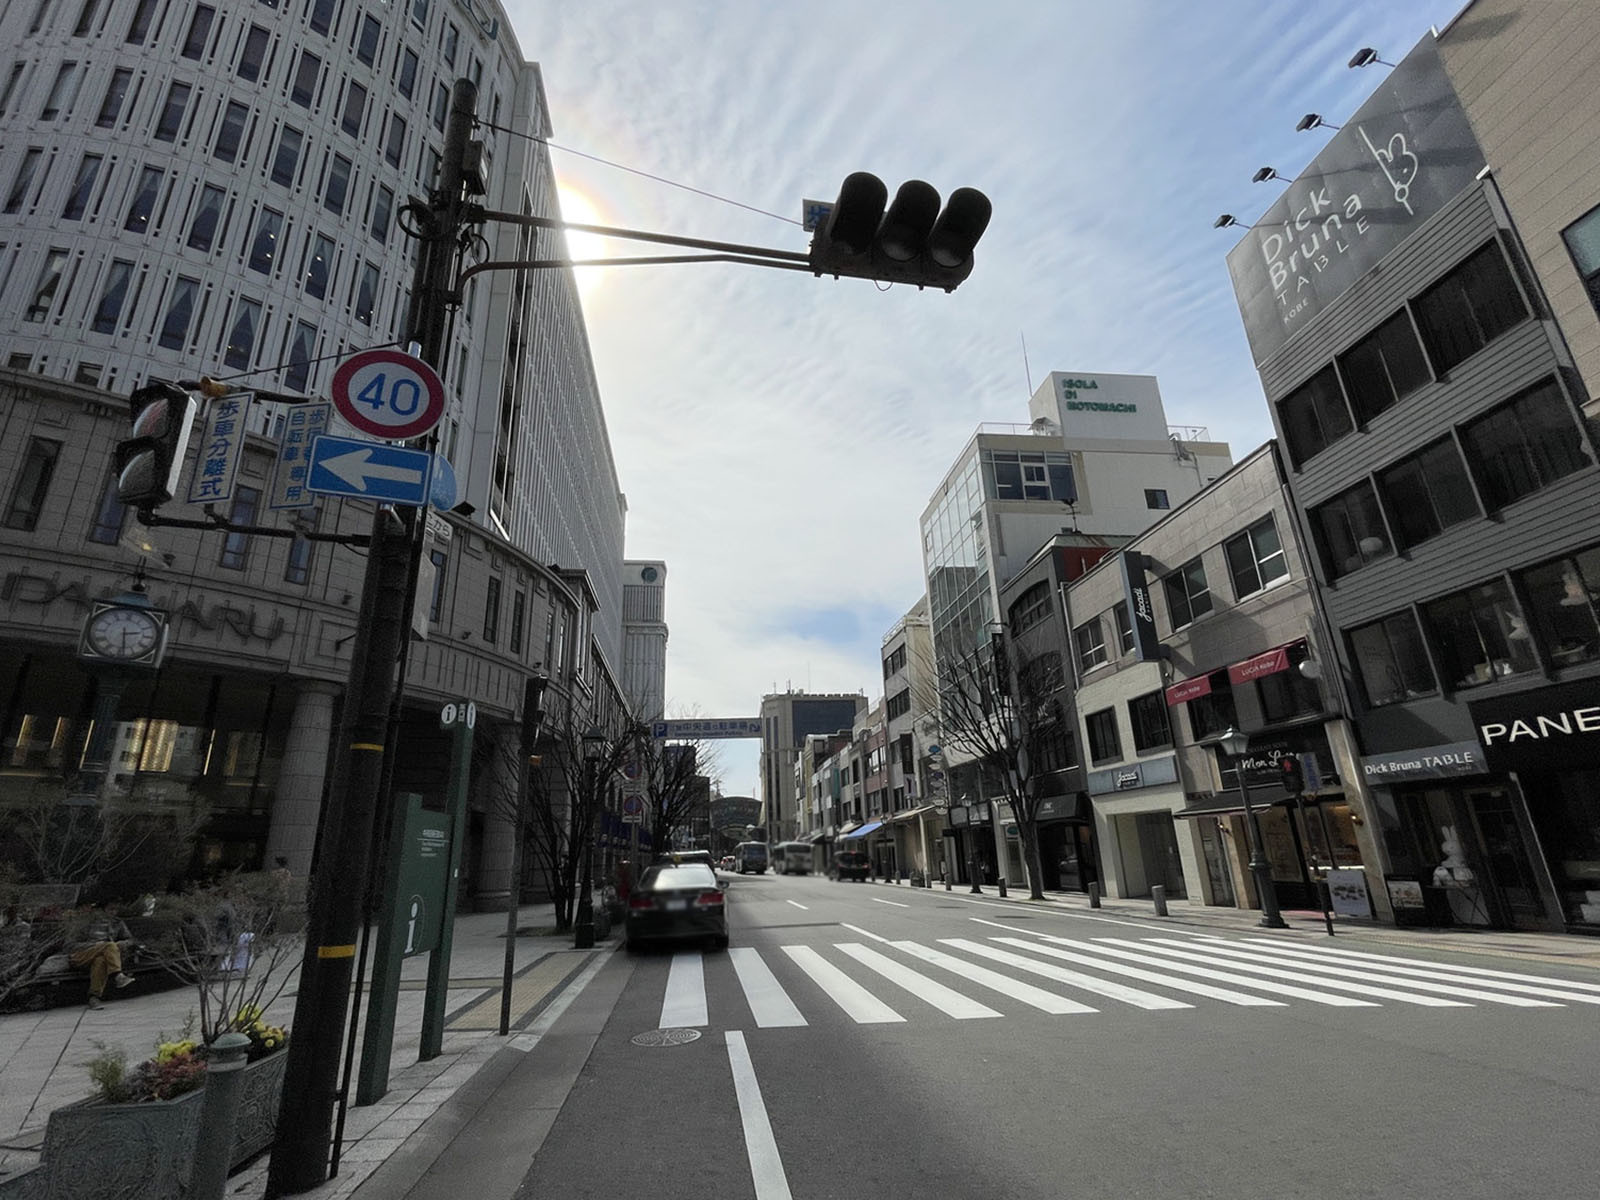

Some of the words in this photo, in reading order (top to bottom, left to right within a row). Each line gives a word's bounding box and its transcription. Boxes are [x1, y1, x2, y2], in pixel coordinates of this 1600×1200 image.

[1261, 188, 1331, 264] Dick
[1268, 194, 1363, 290] Bruna
[1277, 216, 1370, 306] TABLE
[1283, 297, 1310, 324] KOBE
[356, 372, 421, 417] 40
[1062, 378, 1098, 390] ISOLA
[1064, 390, 1077, 400] DI
[1066, 401, 1137, 413] MOTOMACHI
[198, 400, 241, 499] 歩車分離式
[283, 411, 306, 462] 自転車
[1, 571, 284, 644] DAARU
[1480, 706, 1600, 746] PANE
[1364, 762, 1389, 775] Dick
[1389, 760, 1422, 772] Bruna
[1423, 751, 1474, 768] TABLE
